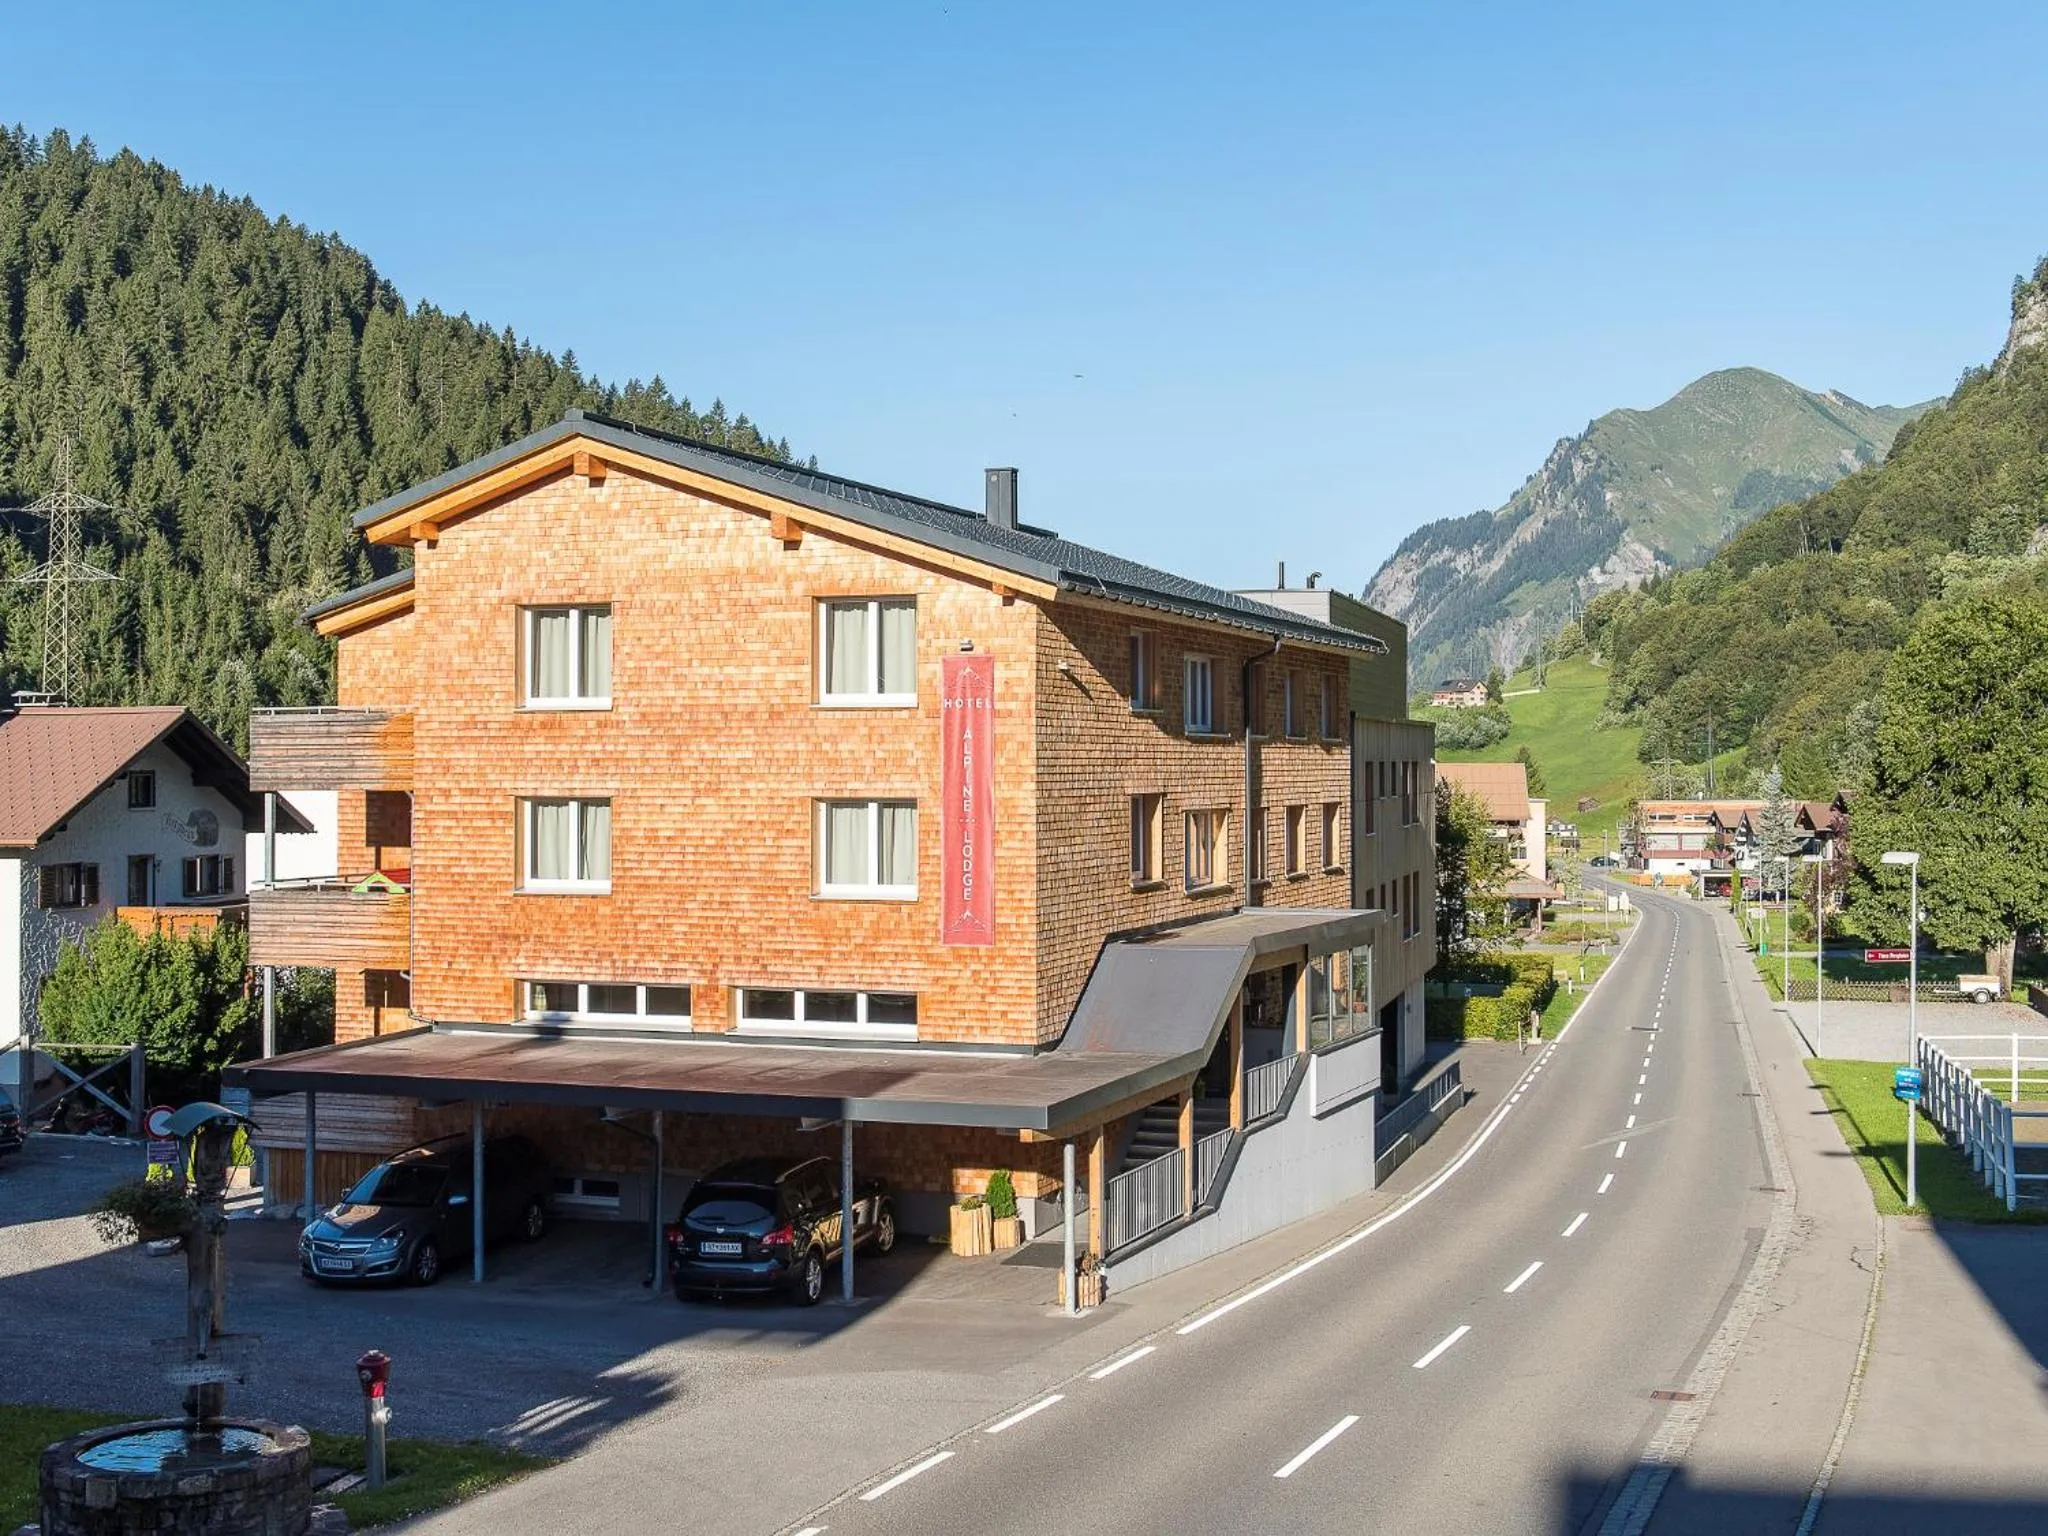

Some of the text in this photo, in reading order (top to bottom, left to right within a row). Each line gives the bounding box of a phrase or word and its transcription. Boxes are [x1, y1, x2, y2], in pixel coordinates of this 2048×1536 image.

[943, 698, 993, 709] HOTEL
[962, 728, 973, 901] ALPINE LODGE
